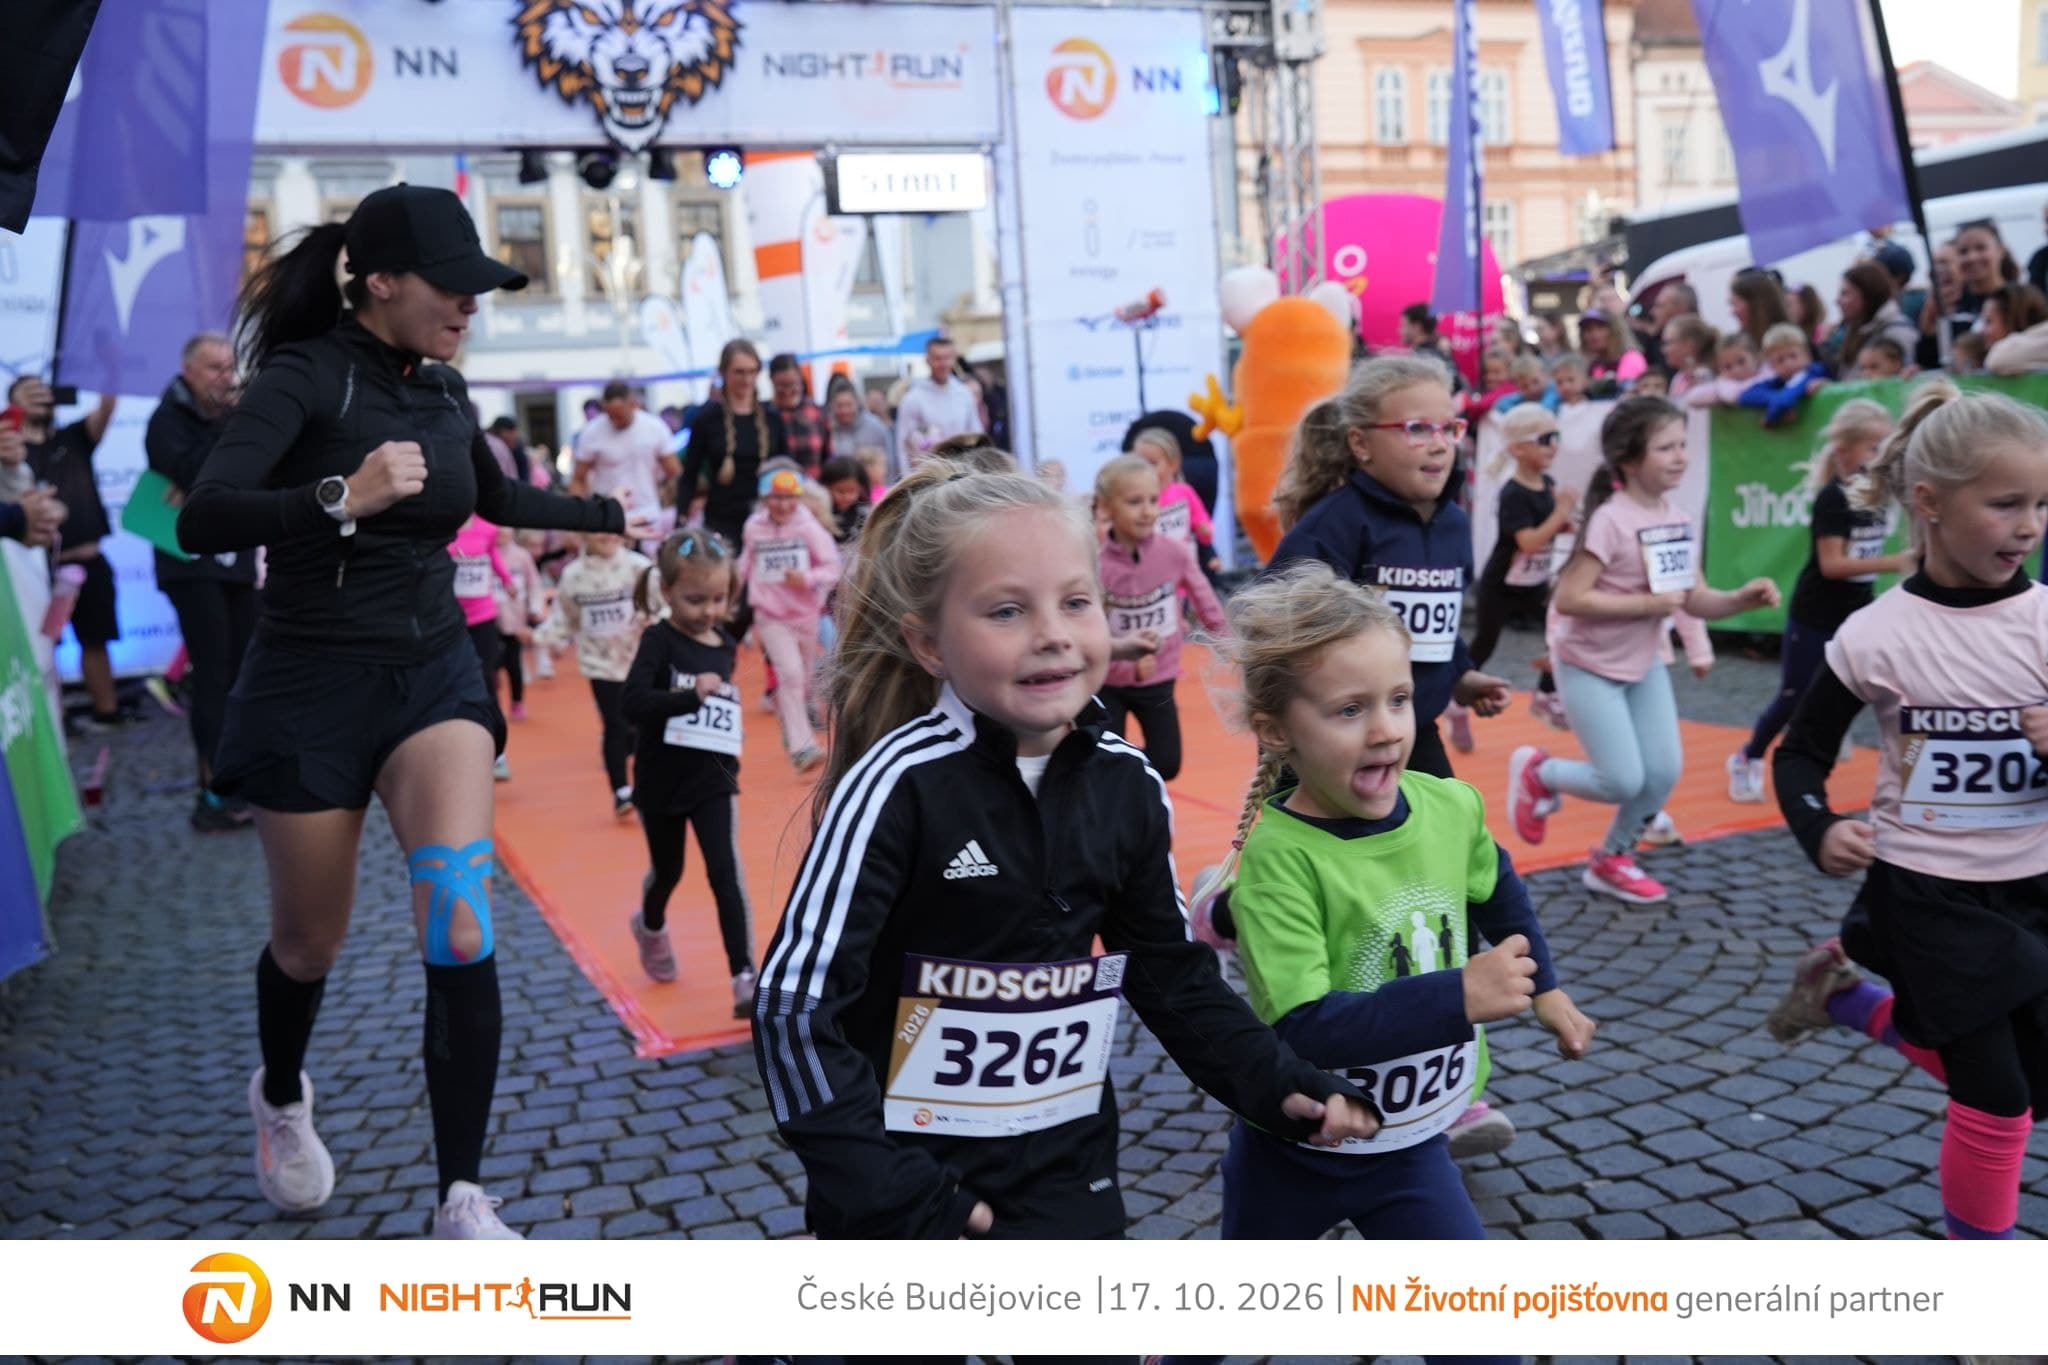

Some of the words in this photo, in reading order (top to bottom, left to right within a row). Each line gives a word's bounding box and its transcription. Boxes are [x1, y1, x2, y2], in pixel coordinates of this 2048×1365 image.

[394, 46, 458, 77] NN
[762, 52, 866, 79] NIGHT
[890, 53, 962, 79] RUN
[1132, 66, 1182, 92] NN
[1378, 566, 1456, 588] KIDSCUP
[1119, 607, 1165, 630] 3173
[1910, 709, 2023, 733] KIDSCU
[943, 864, 999, 880] adidas
[918, 961, 1094, 1001] KIDSCUP
[934, 1020, 1089, 1087] 3262
